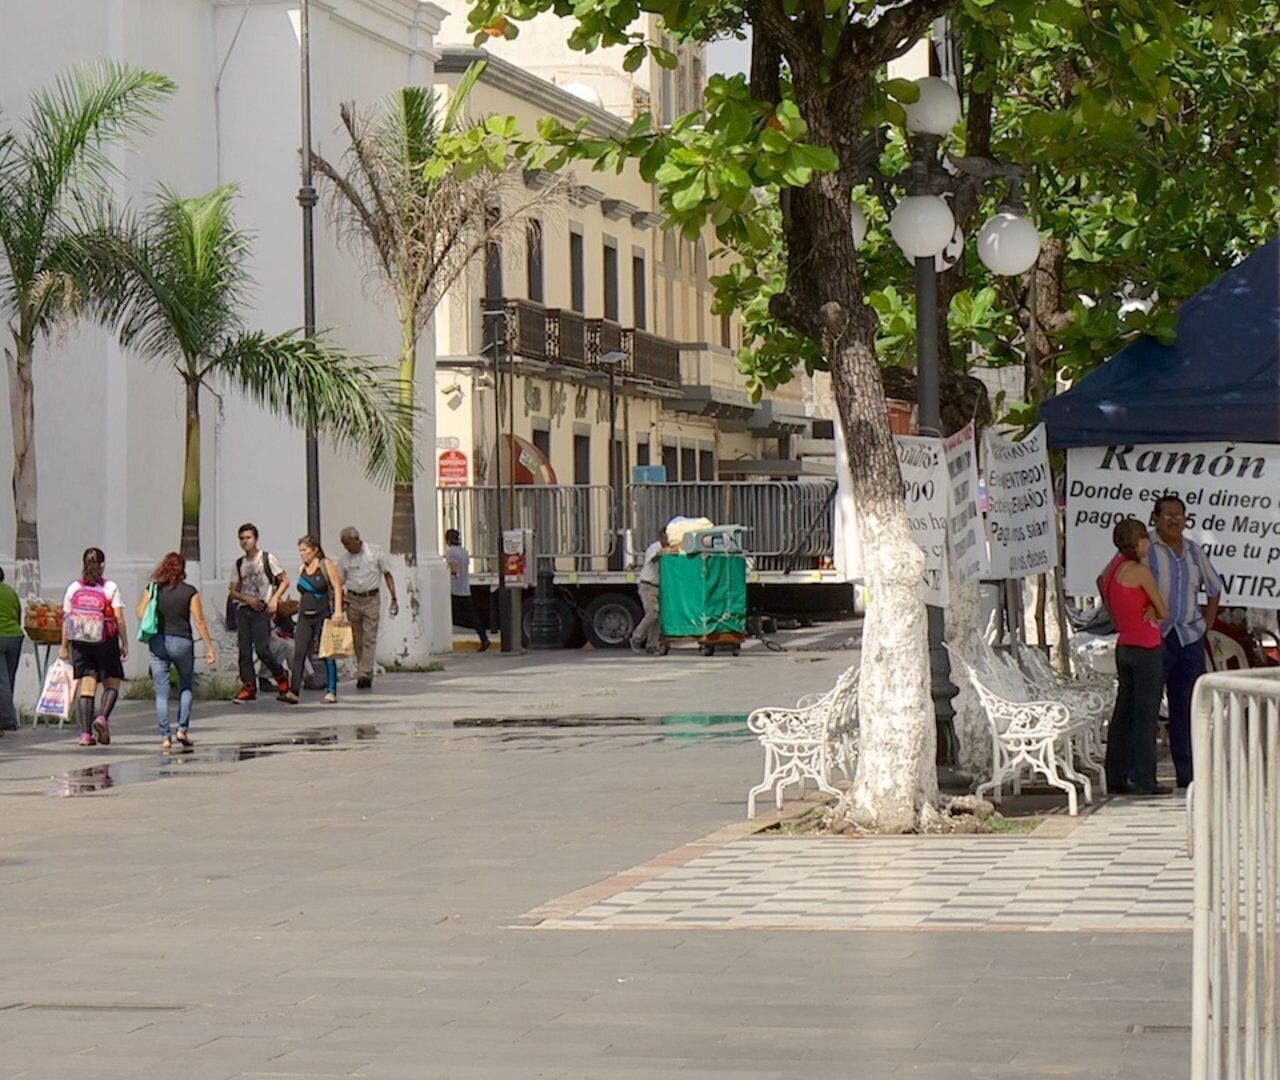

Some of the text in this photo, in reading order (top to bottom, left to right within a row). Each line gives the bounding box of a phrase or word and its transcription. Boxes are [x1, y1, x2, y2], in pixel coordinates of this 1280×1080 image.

[1097, 445, 1267, 479] Ramón
[1070, 480, 1134, 501] Donde
[1186, 488, 1204, 505] el
[1208, 490, 1272, 509] dinero
[1201, 514, 1226, 532] de
[1201, 542, 1237, 562] que
[1243, 542, 1262, 559] tu
[1200, 573, 1280, 598] NTIR
